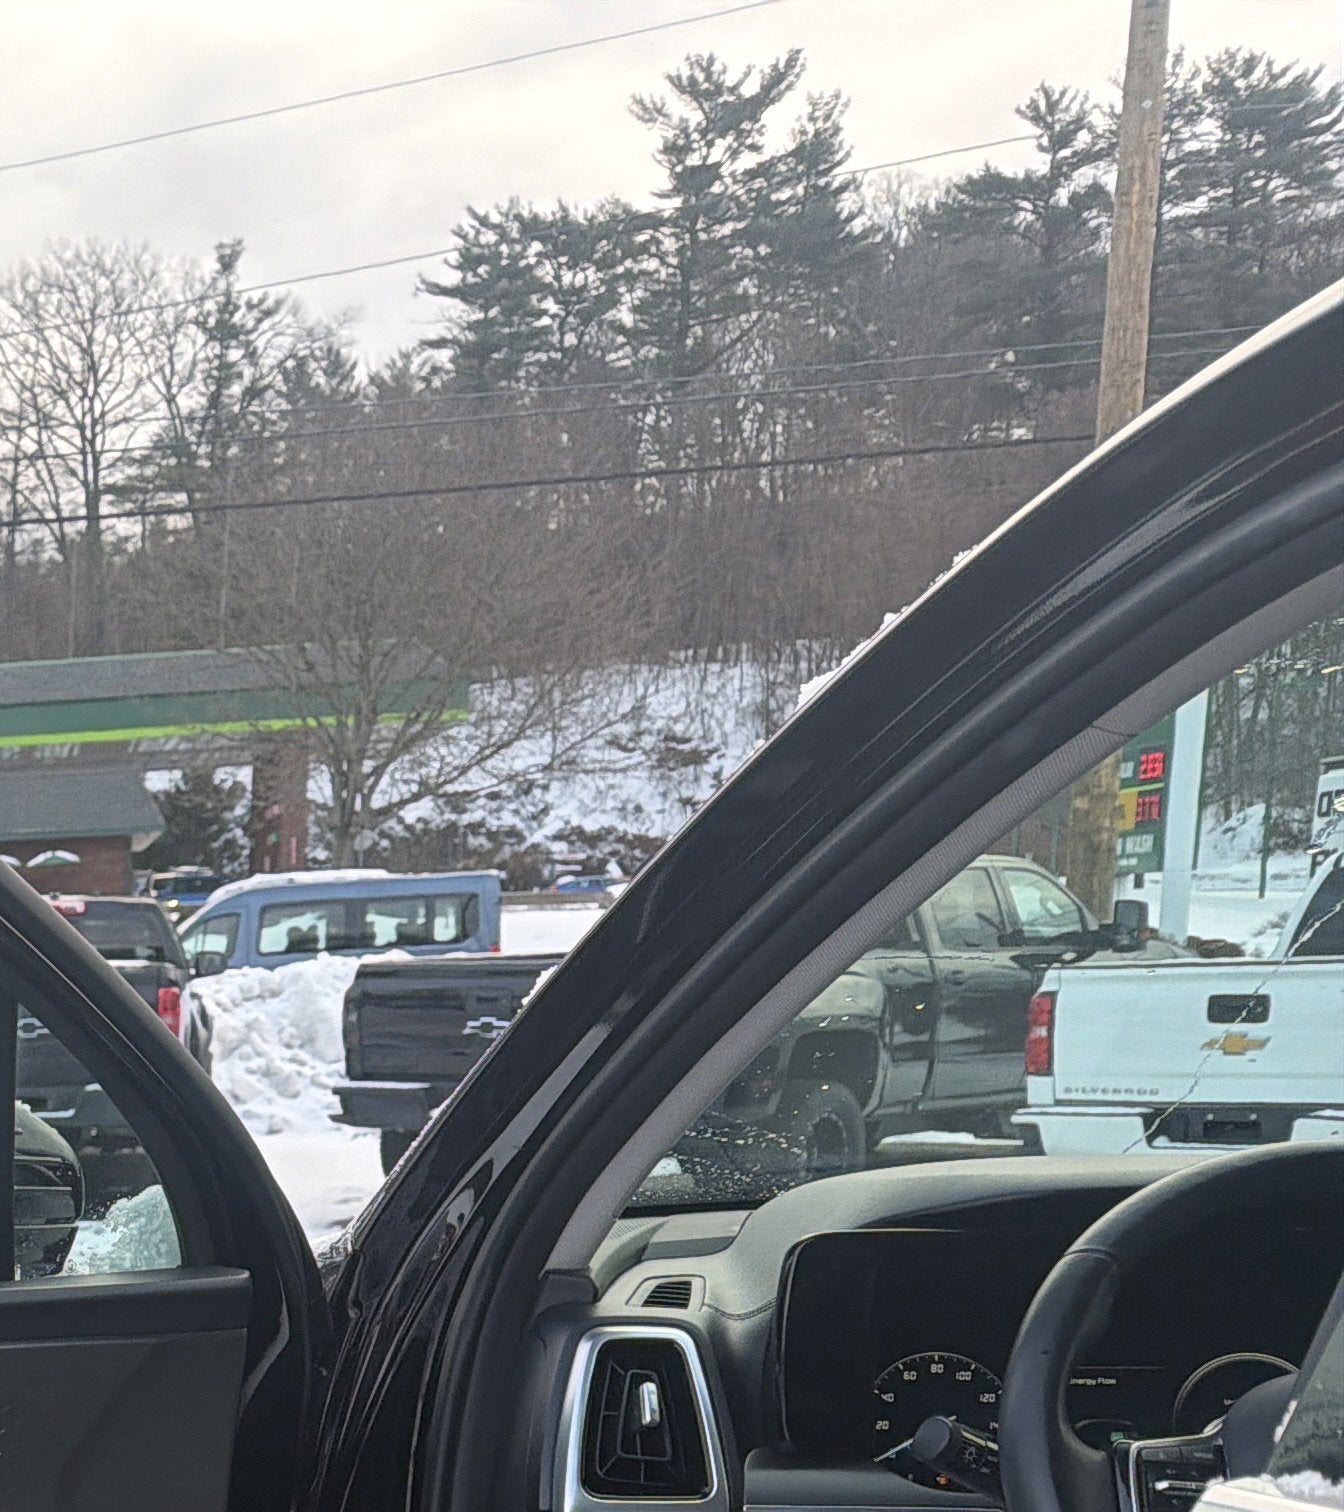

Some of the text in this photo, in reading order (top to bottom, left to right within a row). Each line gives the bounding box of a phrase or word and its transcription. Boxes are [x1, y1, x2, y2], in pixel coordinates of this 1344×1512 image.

[1064, 1086, 1159, 1095] SILVERADO
[930, 1363, 944, 1374] 80
[903, 1371, 917, 1381] 60
[955, 1371, 972, 1381] 100
[881, 1392, 895, 1402] 40
[979, 1392, 996, 1403] 120
[875, 1420, 890, 1430] 20
